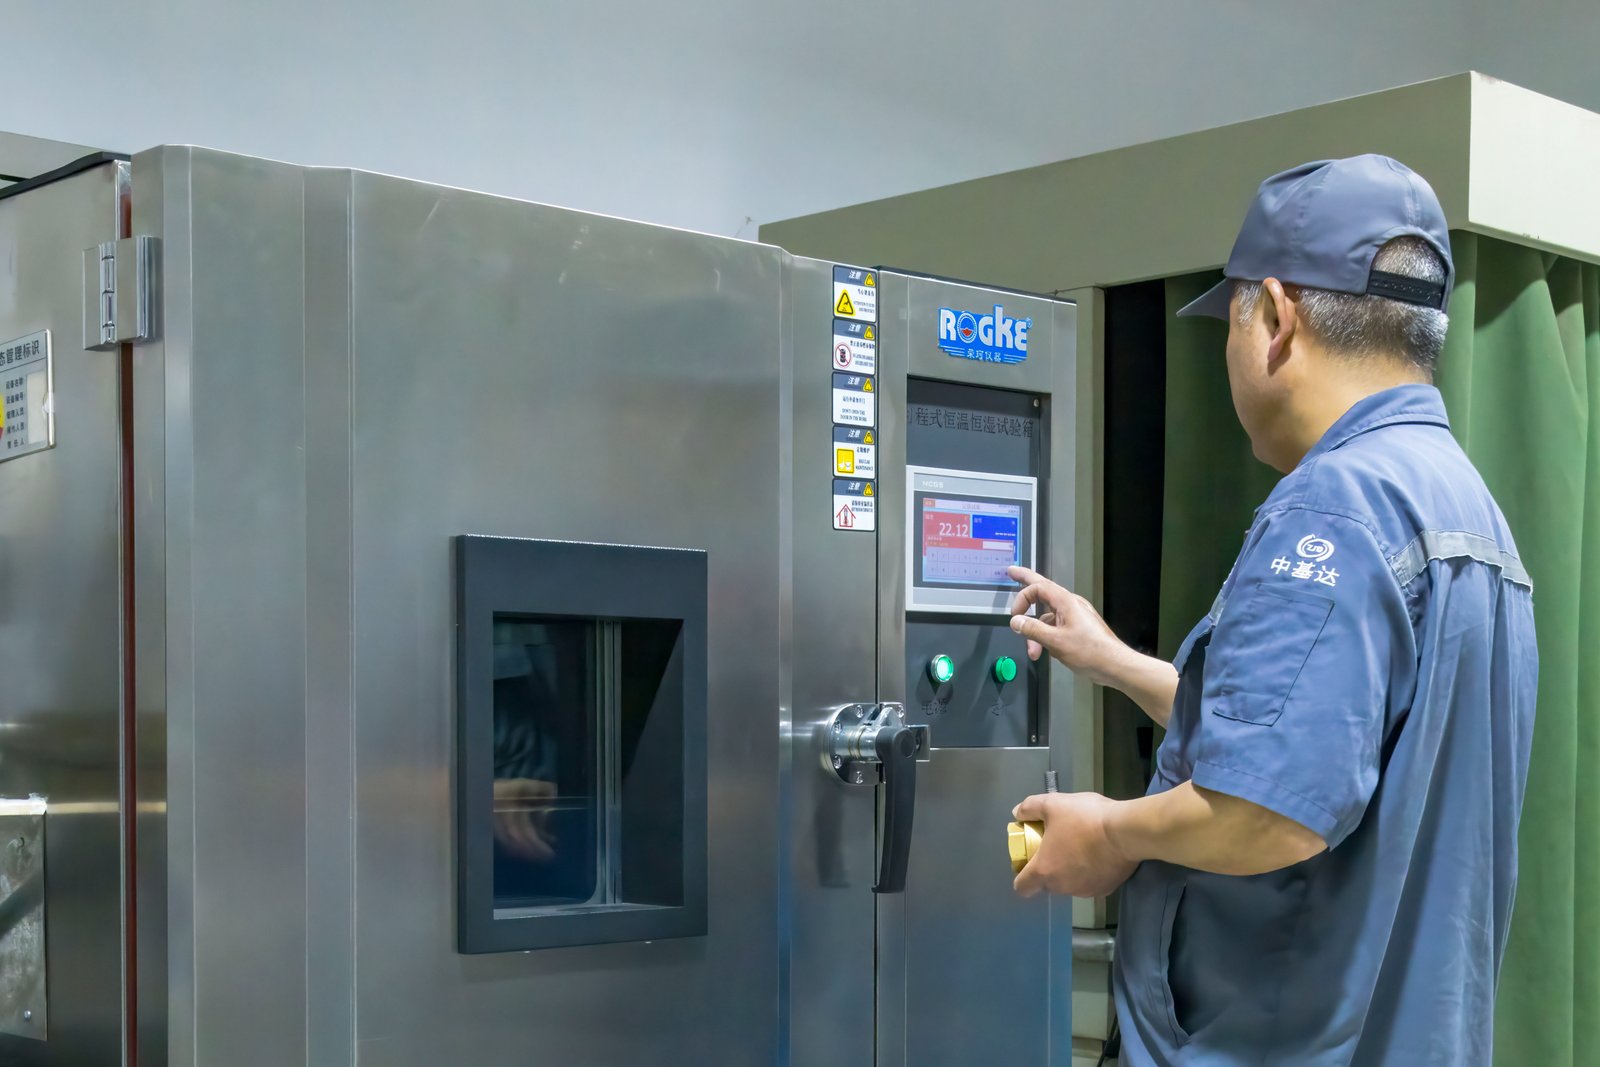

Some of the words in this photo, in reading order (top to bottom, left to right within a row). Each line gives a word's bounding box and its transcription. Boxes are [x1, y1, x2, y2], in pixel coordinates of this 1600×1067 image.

[939, 522, 969, 538] 22.12
[1270, 555, 1340, 587] 中基达
